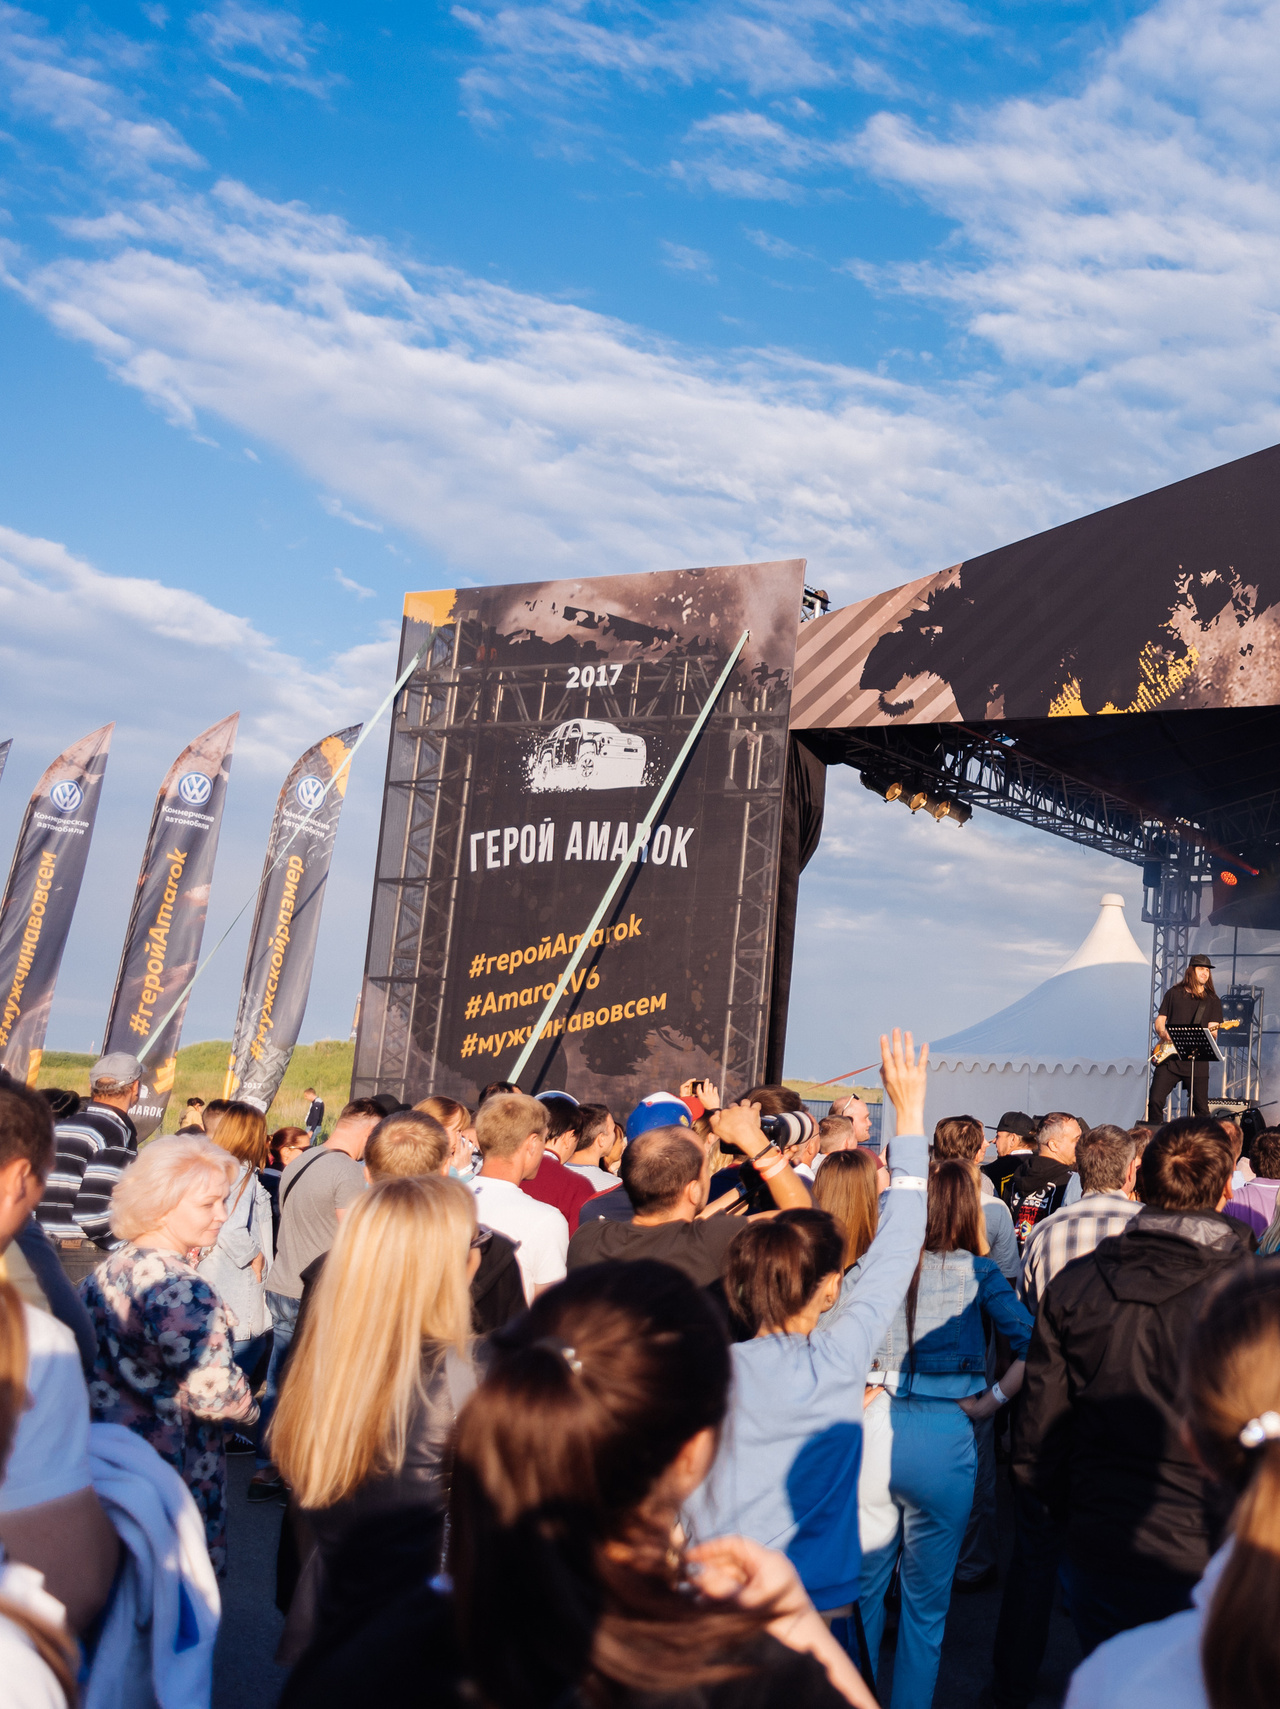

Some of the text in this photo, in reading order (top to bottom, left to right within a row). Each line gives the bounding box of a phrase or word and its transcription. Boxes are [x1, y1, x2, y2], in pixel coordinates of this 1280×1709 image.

[566, 663, 624, 689] 2017
[33, 811, 90, 828] Коммерческие
[162, 805, 215, 823] Коммерческие
[165, 815, 210, 830] автомобили
[36, 820, 85, 835] автомобили
[470, 817, 555, 872] ГЕРОЙ
[129, 847, 189, 1037] #геройAmarok
[250, 854, 305, 1061] #мужскойразмер
[243, 1081, 263, 1089] 2017
[127, 1104, 164, 1118] MAROK
